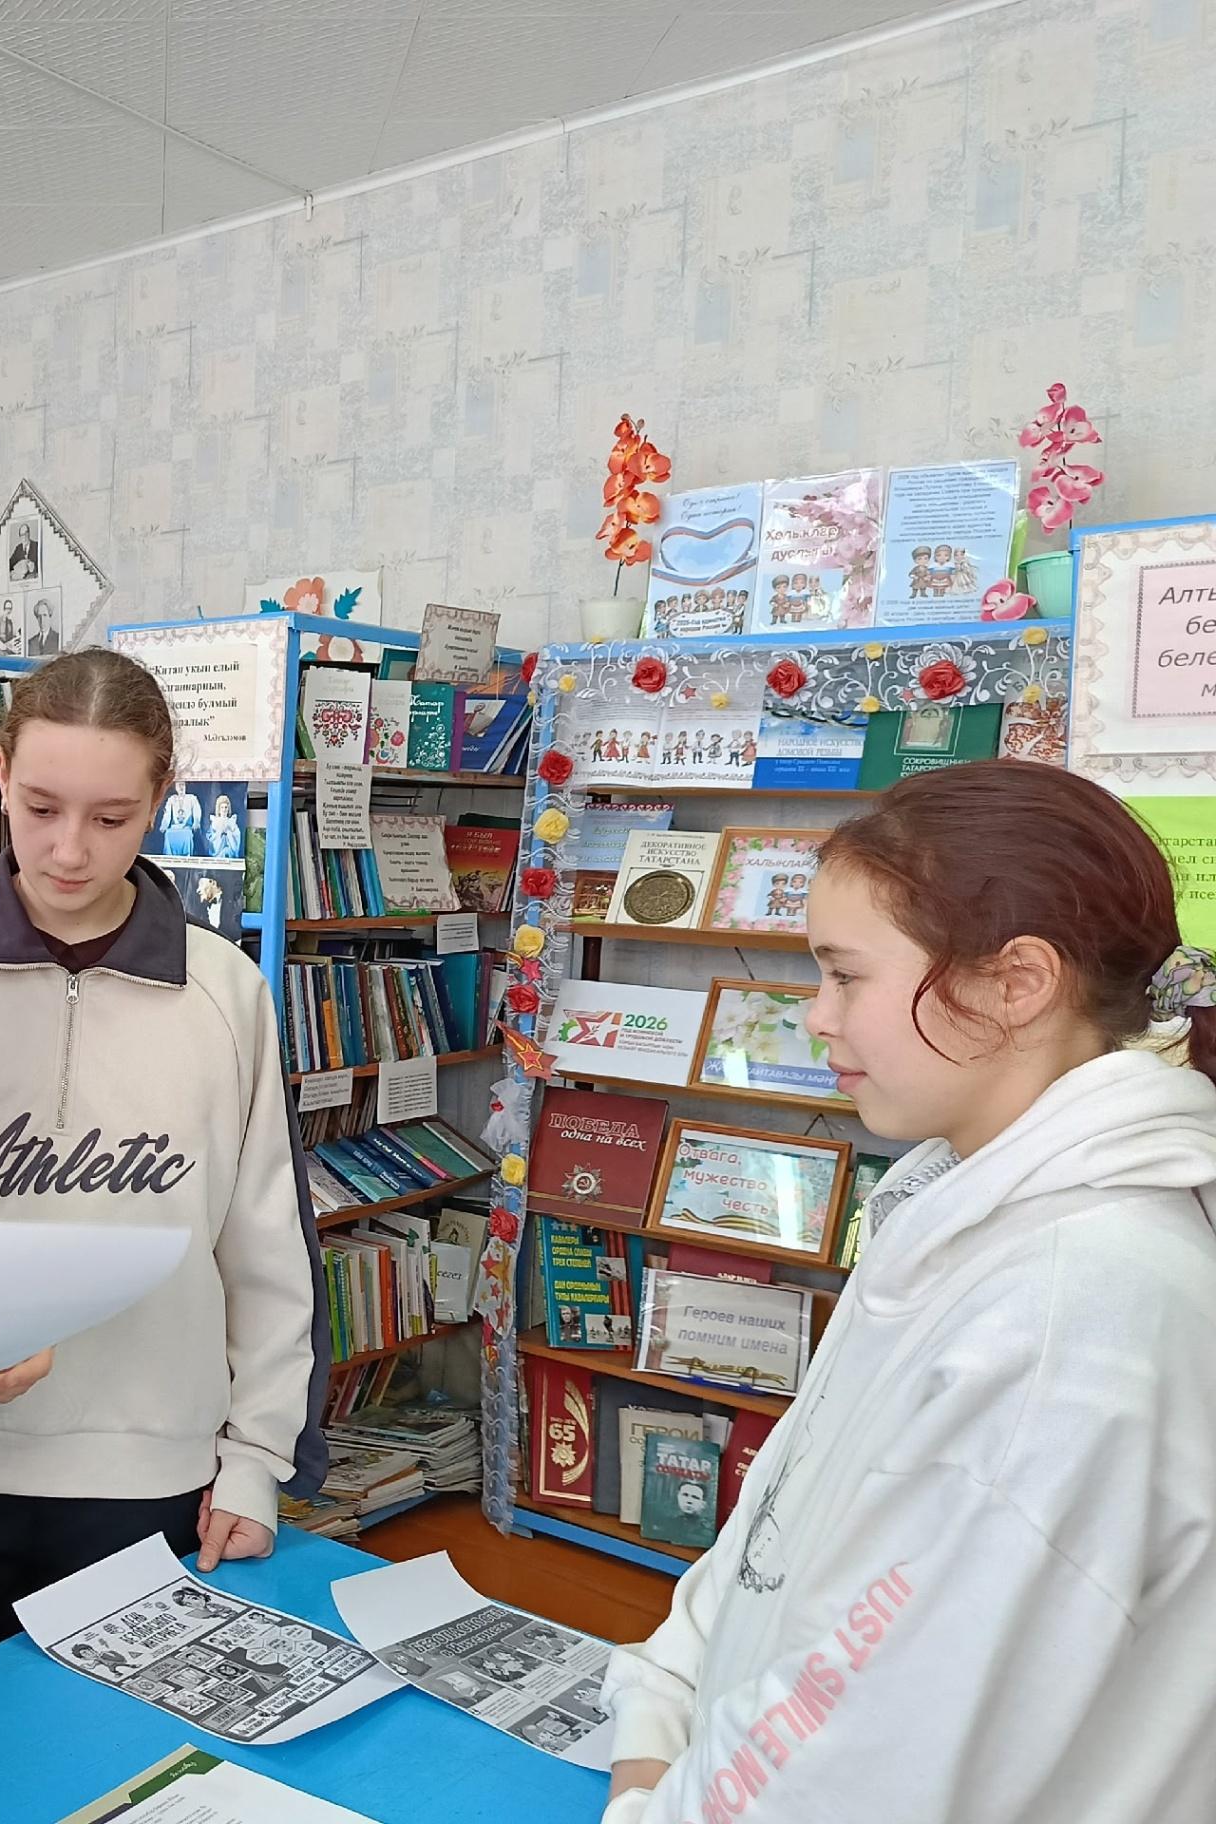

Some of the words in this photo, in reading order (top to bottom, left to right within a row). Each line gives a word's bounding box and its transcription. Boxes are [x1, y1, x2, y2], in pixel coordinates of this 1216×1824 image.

[639, 840, 706, 850] ДЕКОРАТИВНОЕ
[647, 849, 698, 858] ИСКУССТВО
[638, 856, 701, 866] ТАТАРСТАНА
[624, 1014, 668, 1030] 2026
[548, 1113, 640, 1139] ПОБЕДА
[561, 1128, 593, 1142] одна
[595, 1135, 613, 1145] на
[615, 1136, 646, 1152] всех
[684, 1170, 768, 1191] мужество
[722, 1198, 769, 1215] честь
[683, 1305, 735, 1324] Героев
[737, 1314, 786, 1331] наших
[678, 1329, 737, 1347] помним
[740, 1340, 788, 1355] имена
[549, 1423, 576, 1442] 65
[656, 1452, 712, 1473] ТАТАР
[120, 1611, 147, 1629] ДЕНЬ
[834, 1560, 915, 1672] JUST
[408, 1608, 508, 1654] БЕЗОПАСНОСТЬ
[747, 1651, 845, 1770] SMILE
